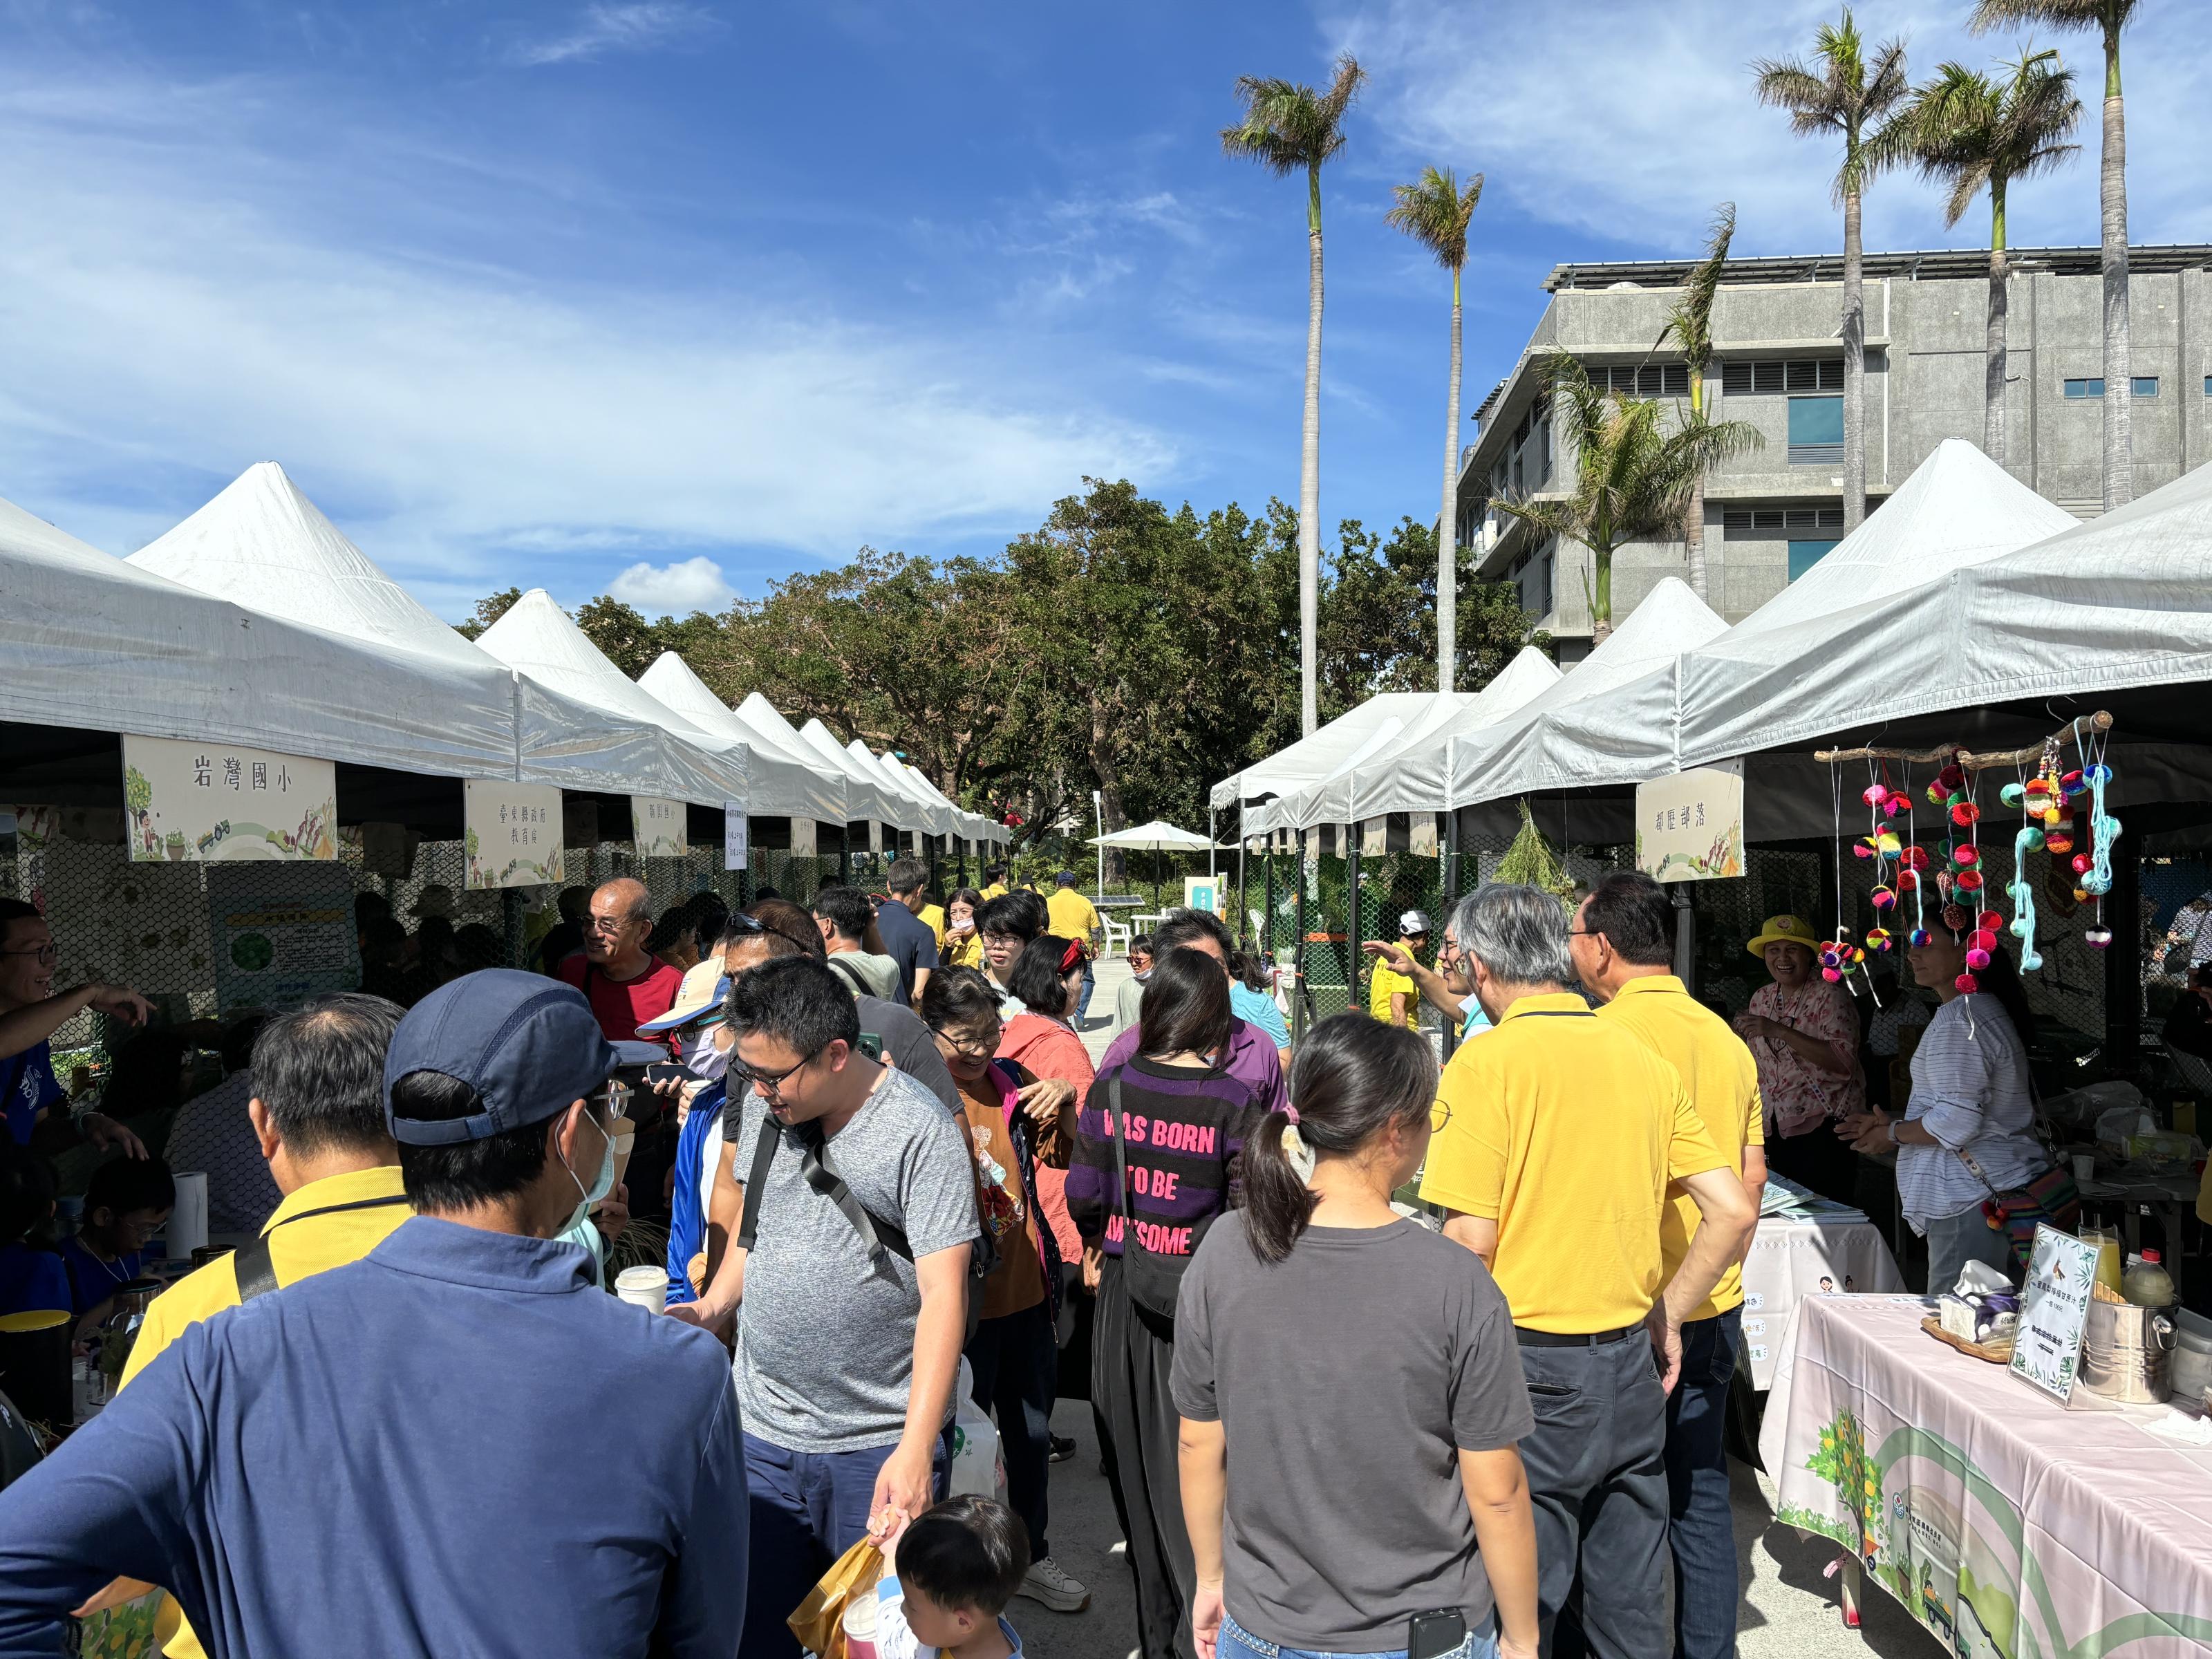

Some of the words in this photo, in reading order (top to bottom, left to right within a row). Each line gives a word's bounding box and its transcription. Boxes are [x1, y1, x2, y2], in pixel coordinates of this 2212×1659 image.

[193, 755, 291, 792] 岩灣國小
[499, 803, 545, 824] 臺東縣政府
[1151, 1119, 1216, 1154] BORN
[1125, 1165, 1149, 1195] TO
[1150, 1169, 1180, 1201] BE
[1105, 1212, 1193, 1255] AWSOME
